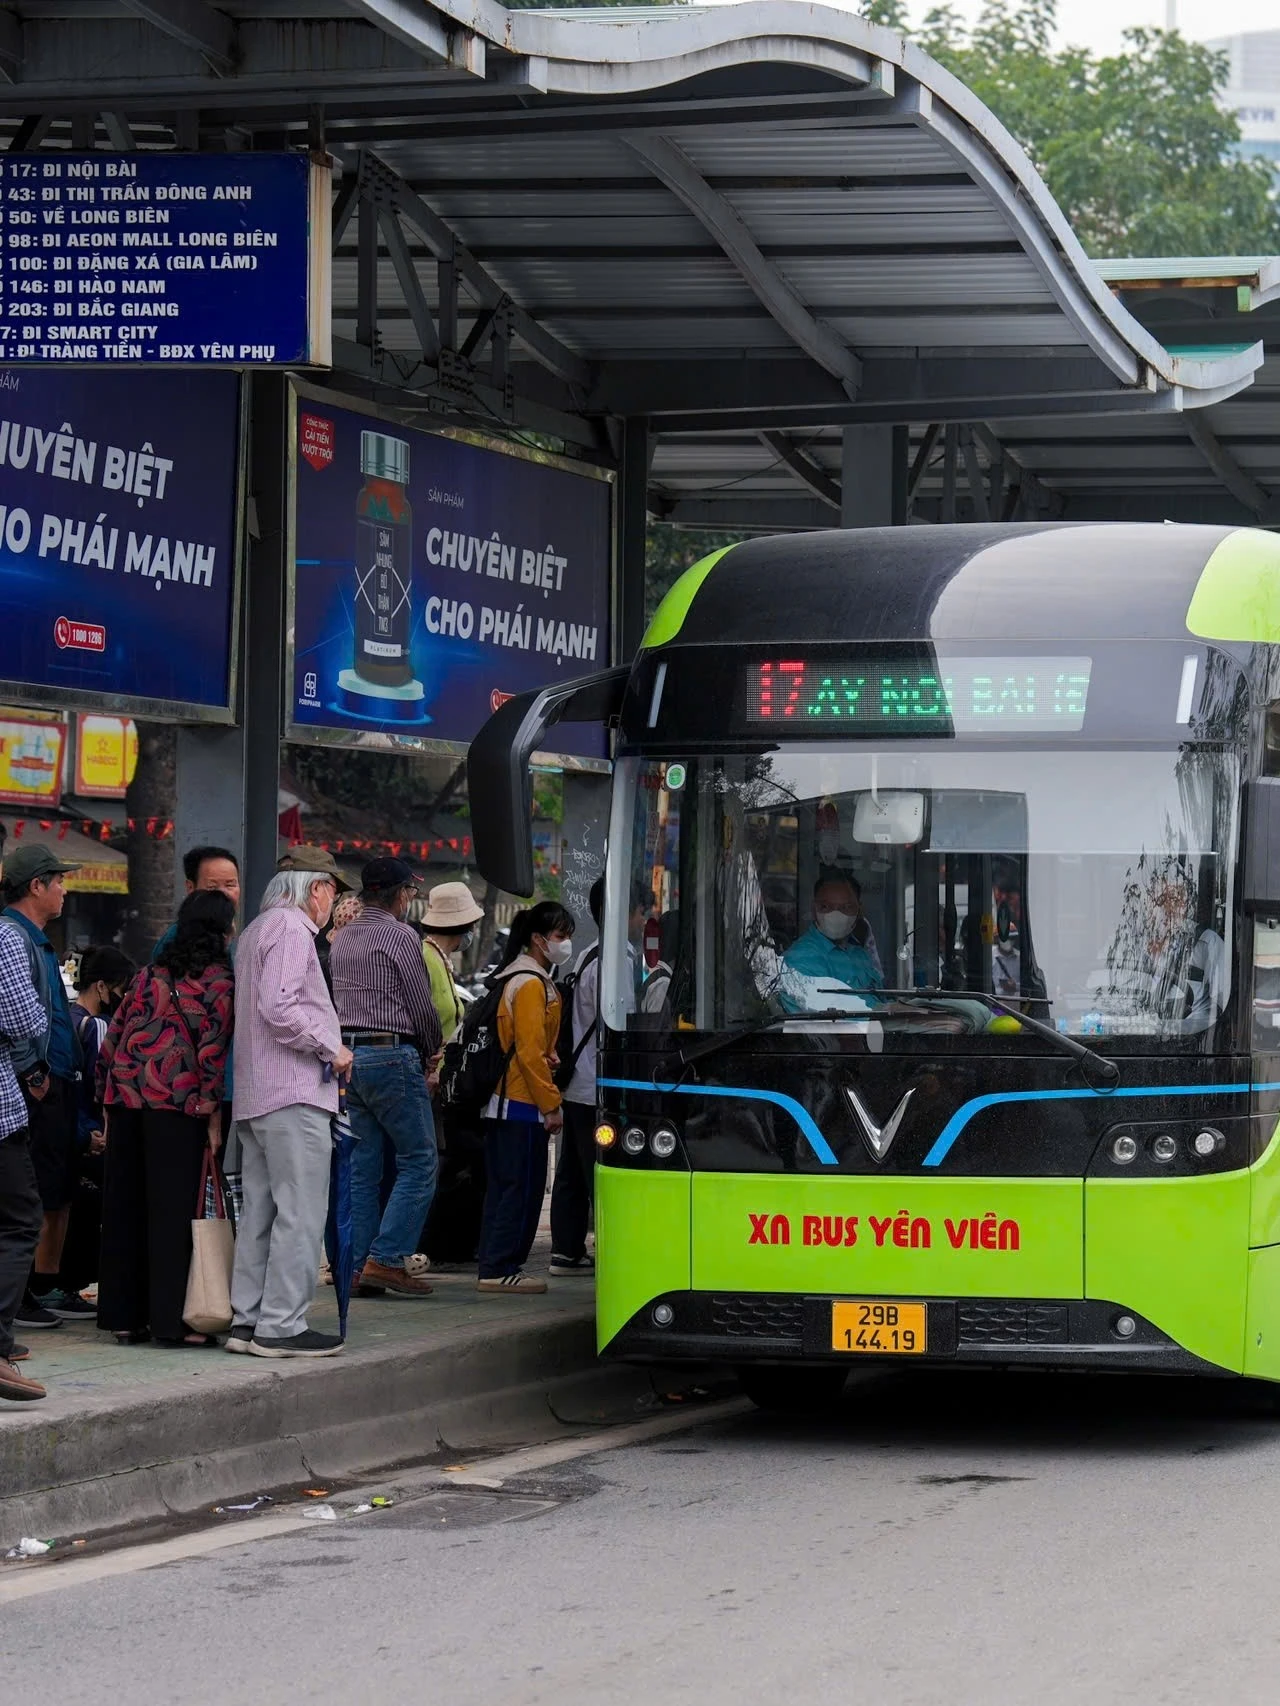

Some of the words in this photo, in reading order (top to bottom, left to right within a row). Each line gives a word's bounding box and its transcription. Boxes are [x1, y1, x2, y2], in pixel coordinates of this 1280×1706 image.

[10, 164, 37, 177] 17:
[43, 164, 61, 177] ĐI
[68, 160, 100, 180] NỘI
[106, 160, 137, 177] BÀI
[8, 188, 36, 201] 43:
[42, 188, 60, 200] ĐI
[66, 188, 95, 203] THỊ
[101, 182, 149, 200] TRẤN
[155, 183, 207, 200] ĐÔNG
[213, 186, 252, 200] ANH
[9, 211, 37, 224] 50:
[43, 205, 65, 224] VỀ
[71, 210, 120, 224] LONG
[126, 207, 169, 223] BIÊN
[8, 234, 38, 247] 98:
[42, 234, 61, 247] ĐI
[67, 233, 117, 247] AEON
[123, 233, 173, 246] MALL
[179, 232, 227, 246] LONG
[233, 229, 278, 246] BIÊN
[9, 257, 48, 270] 100:
[53, 257, 72, 270] ĐI
[77, 252, 129, 273] ĐẶNG
[135, 253, 160, 270] XÁ
[166, 256, 205, 271] (GIA
[210, 252, 258, 271] LÂM)
[10, 280, 49, 293] 146:
[54, 280, 72, 293] ĐI
[79, 274, 116, 293] HÀO
[122, 280, 166, 293] NAM
[8, 303, 48, 316] 203:
[53, 303, 72, 316] ĐI
[78, 297, 115, 316] BẮC
[121, 302, 179, 316] GIANG
[22, 326, 41, 339] ĐI
[47, 326, 112, 339] SMART
[118, 325, 158, 339] CITY
[17, 345, 35, 358] ĐI
[40, 341, 98, 358] TRÀNG
[103, 340, 142, 358] TIỀN
[160, 345, 195, 358] BĐX
[200, 342, 234, 358] YÊN
[240, 345, 275, 362] PHỤ
[102, 441, 173, 508] BIỆT
[38, 513, 118, 570] PHÁI
[124, 531, 216, 591] MẠNH
[426, 526, 516, 581] CHUYÊN
[520, 544, 568, 599] BIỆT
[425, 595, 474, 640] CHO
[479, 603, 531, 650] PHÁI
[536, 619, 598, 665] MẠNH
[760, 663, 804, 715] 17
[748, 1214, 791, 1245] XN
[803, 1215, 859, 1247] BUS
[868, 1209, 931, 1248] YÊN
[944, 1212, 1020, 1250] VIÊN
[858, 1305, 899, 1326] 29B
[844, 1330, 916, 1351] 144.19
